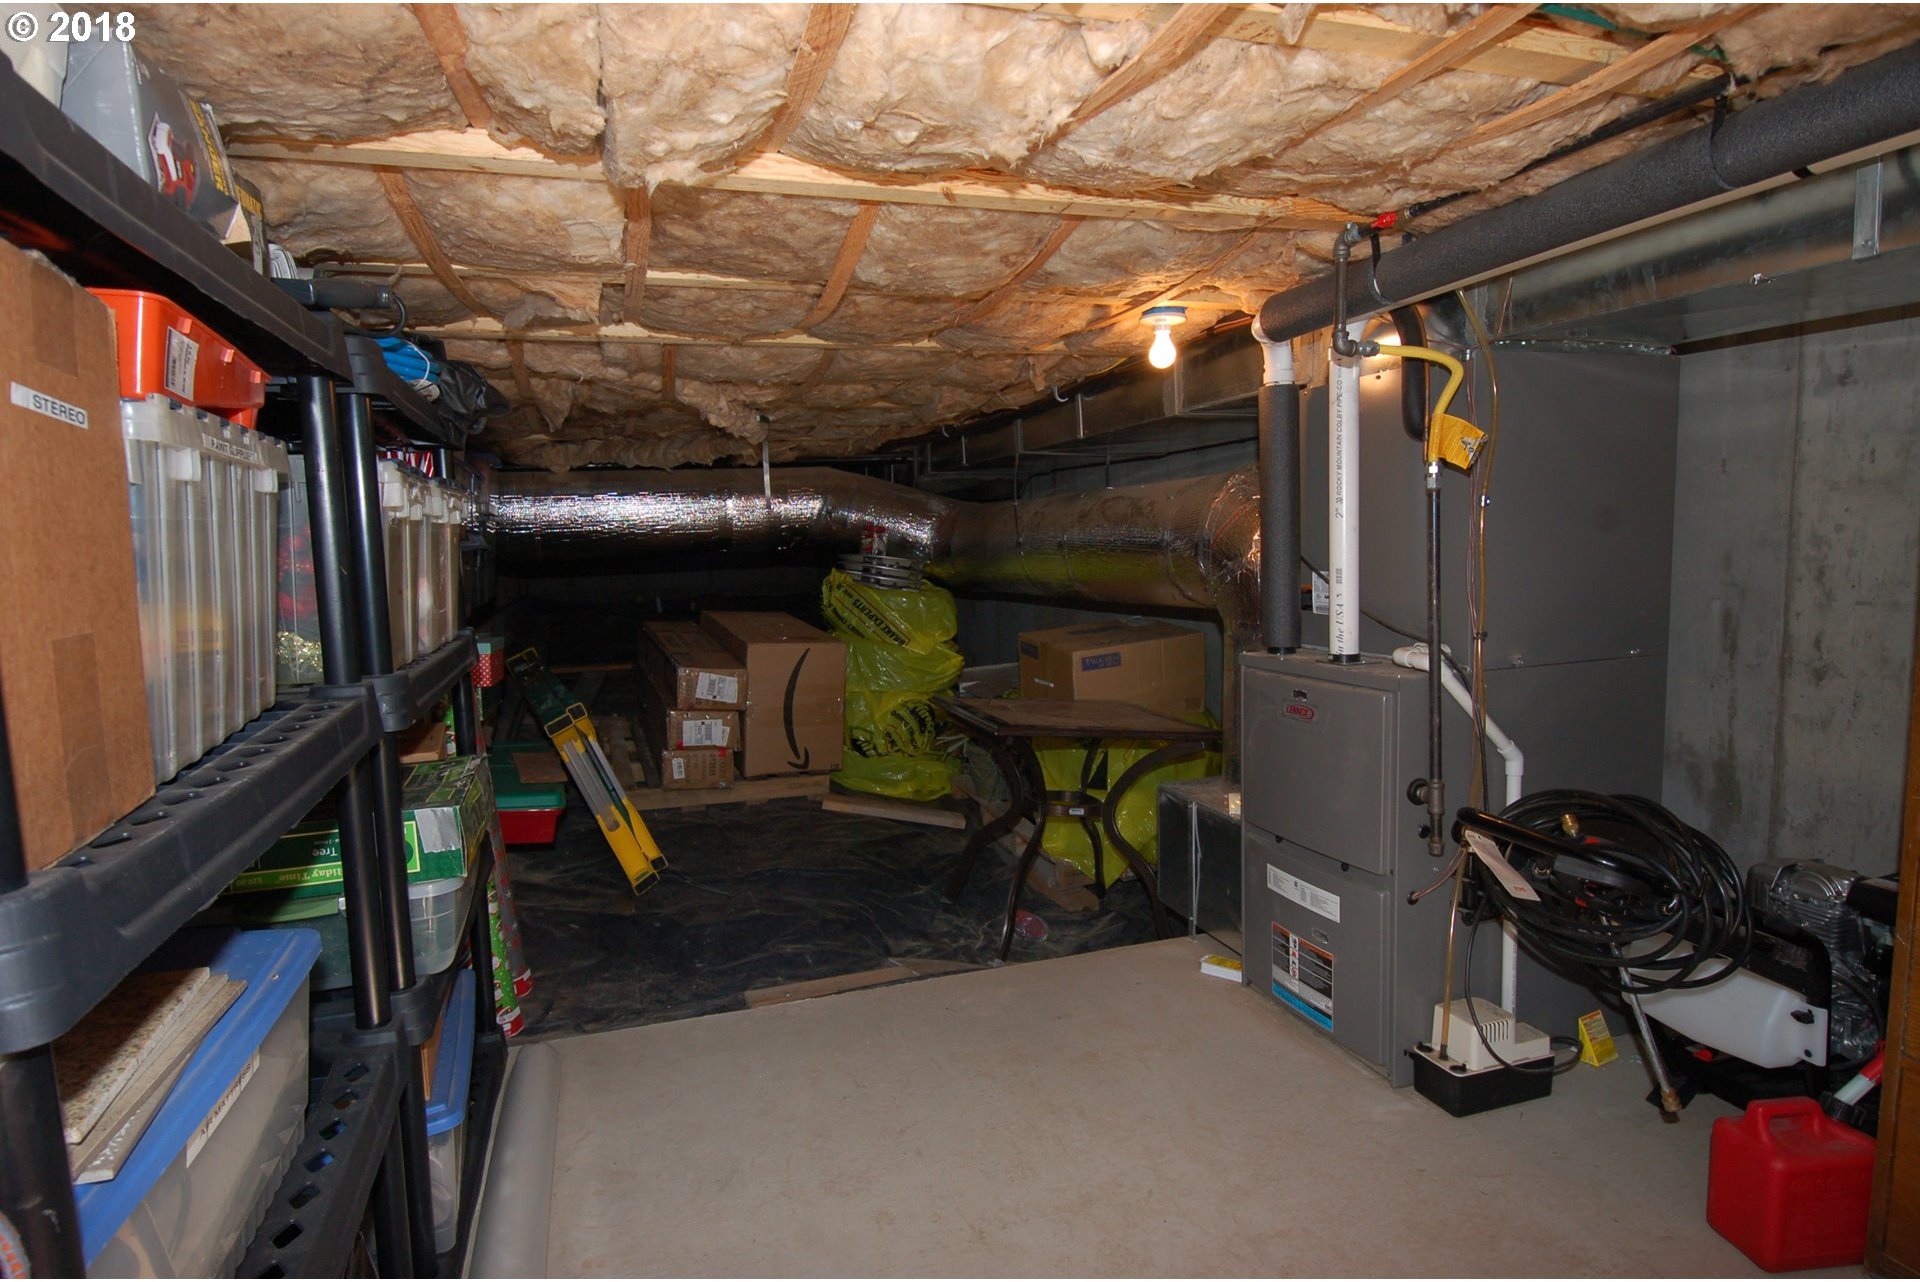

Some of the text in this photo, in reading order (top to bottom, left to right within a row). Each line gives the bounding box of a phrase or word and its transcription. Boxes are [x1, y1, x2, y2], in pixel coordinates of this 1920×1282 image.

[32, 394, 86, 425] STEREO
[1335, 434, 1343, 470] MOUNTAIN
[1335, 471, 1343, 496] ROCKY
[1335, 603, 1345, 625] USA
[1335, 628, 1344, 644] the
[311, 846, 339, 857] Tree
